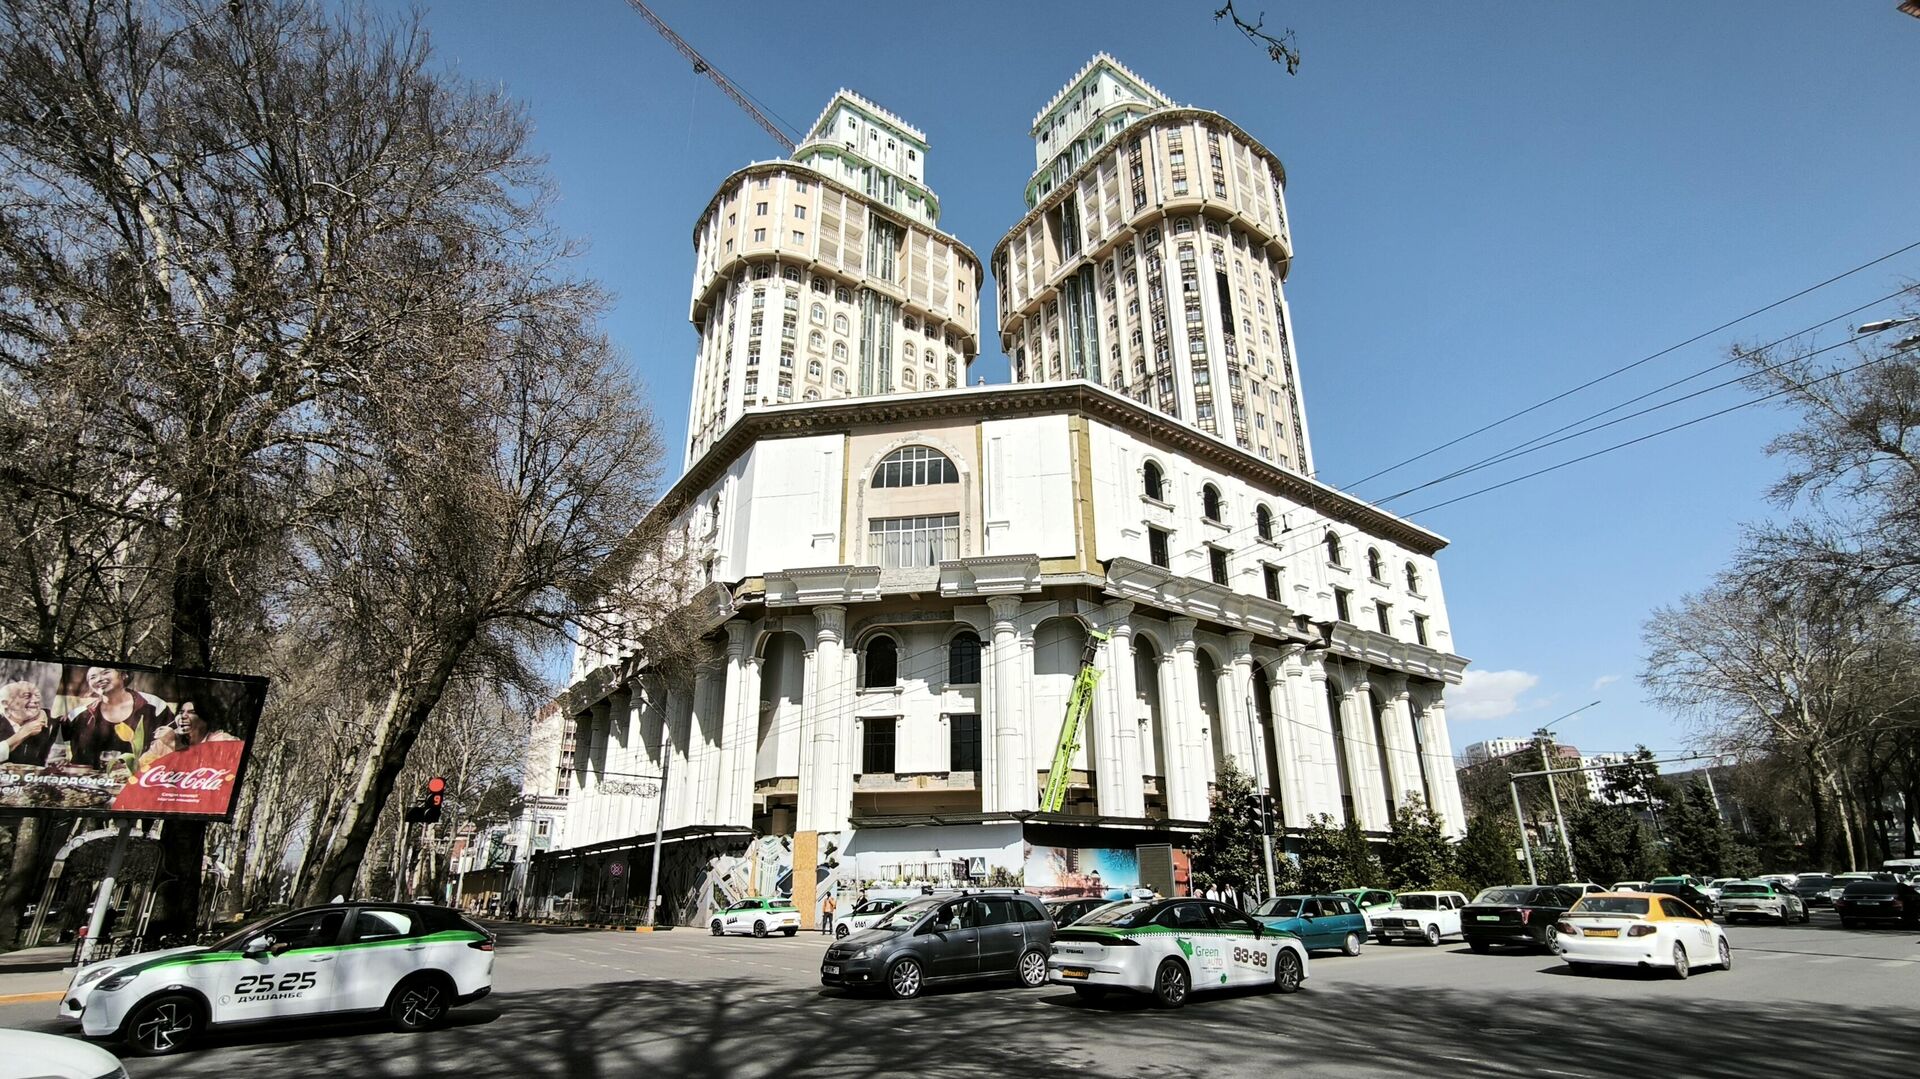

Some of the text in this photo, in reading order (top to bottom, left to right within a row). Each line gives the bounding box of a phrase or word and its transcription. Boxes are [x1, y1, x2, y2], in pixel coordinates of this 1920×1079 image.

[24, 773, 115, 787] бигардонед
[140, 765, 231, 791] Coca-Cola
[1195, 946, 1219, 957] Green
[1233, 946, 1268, 967] 33-33
[238, 992, 304, 1003] ДУШАНБЕ
